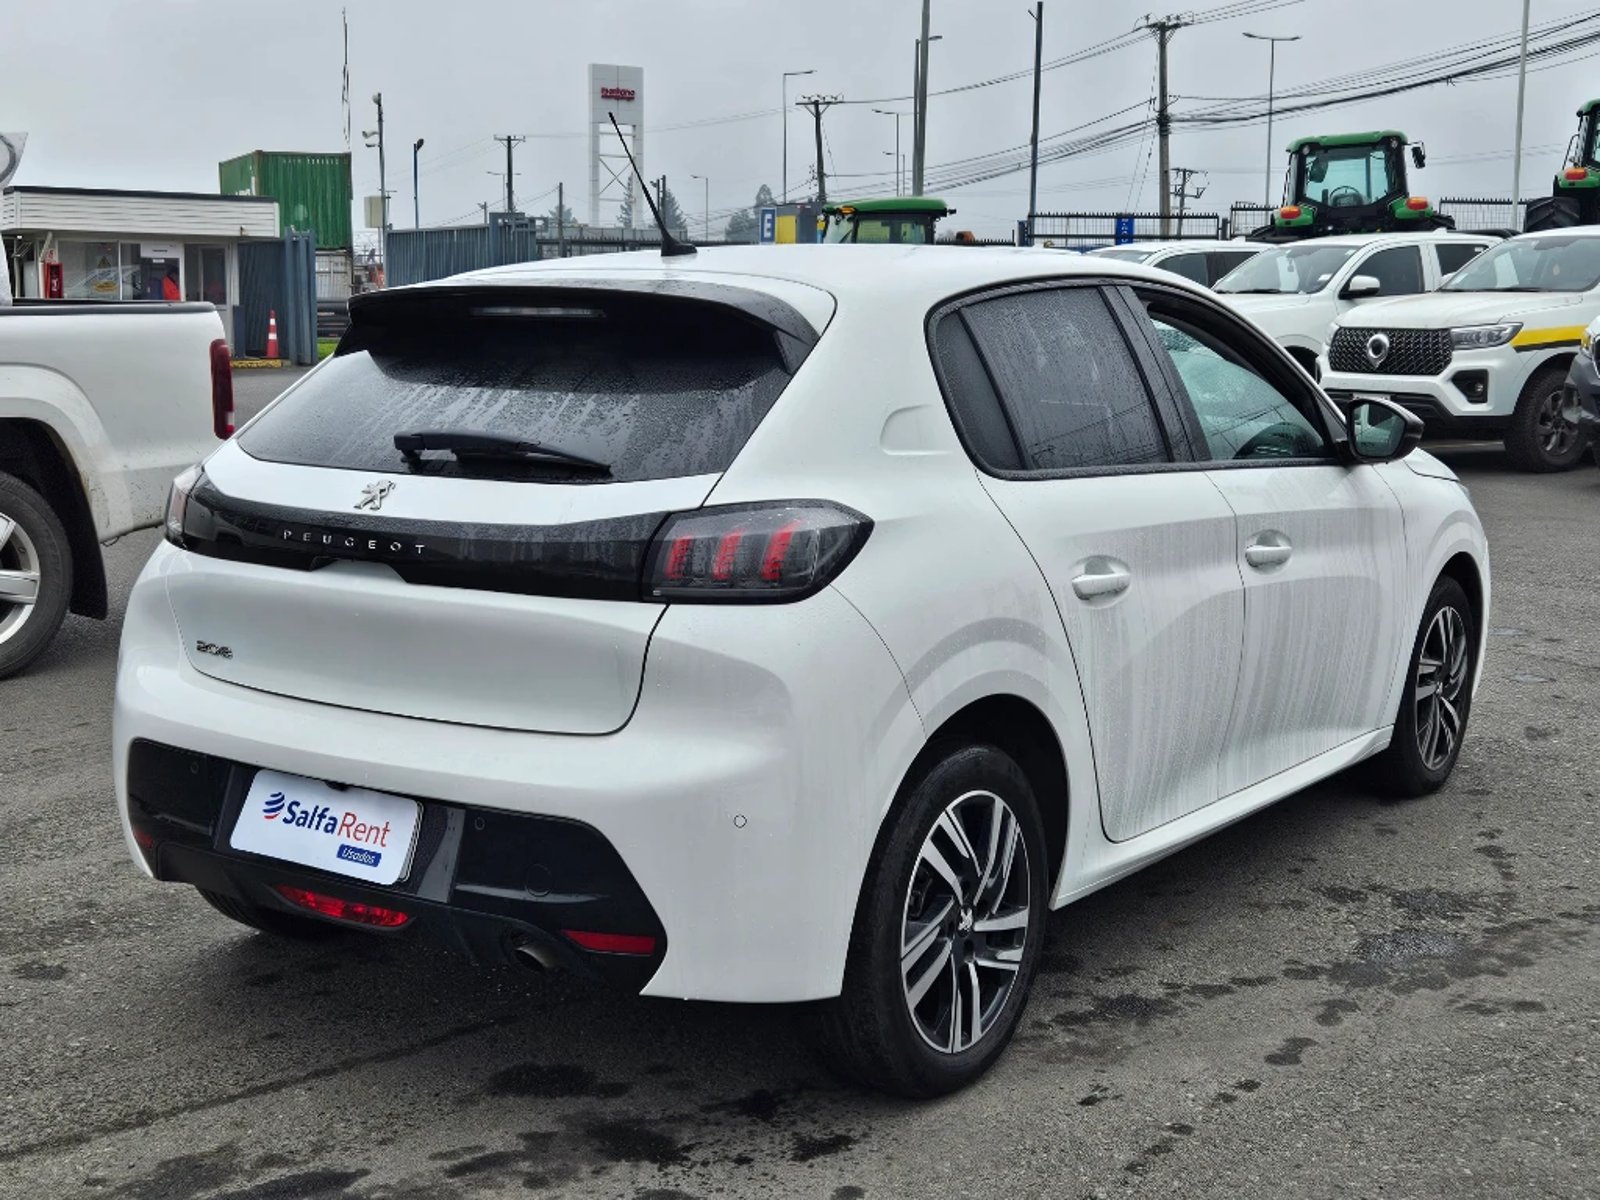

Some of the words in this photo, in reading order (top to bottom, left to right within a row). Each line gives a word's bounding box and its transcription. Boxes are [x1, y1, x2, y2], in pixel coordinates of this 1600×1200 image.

[283, 529, 425, 554] PEUGEOT
[282, 800, 391, 847] SalfaRent
[341, 847, 376, 865] Usados
